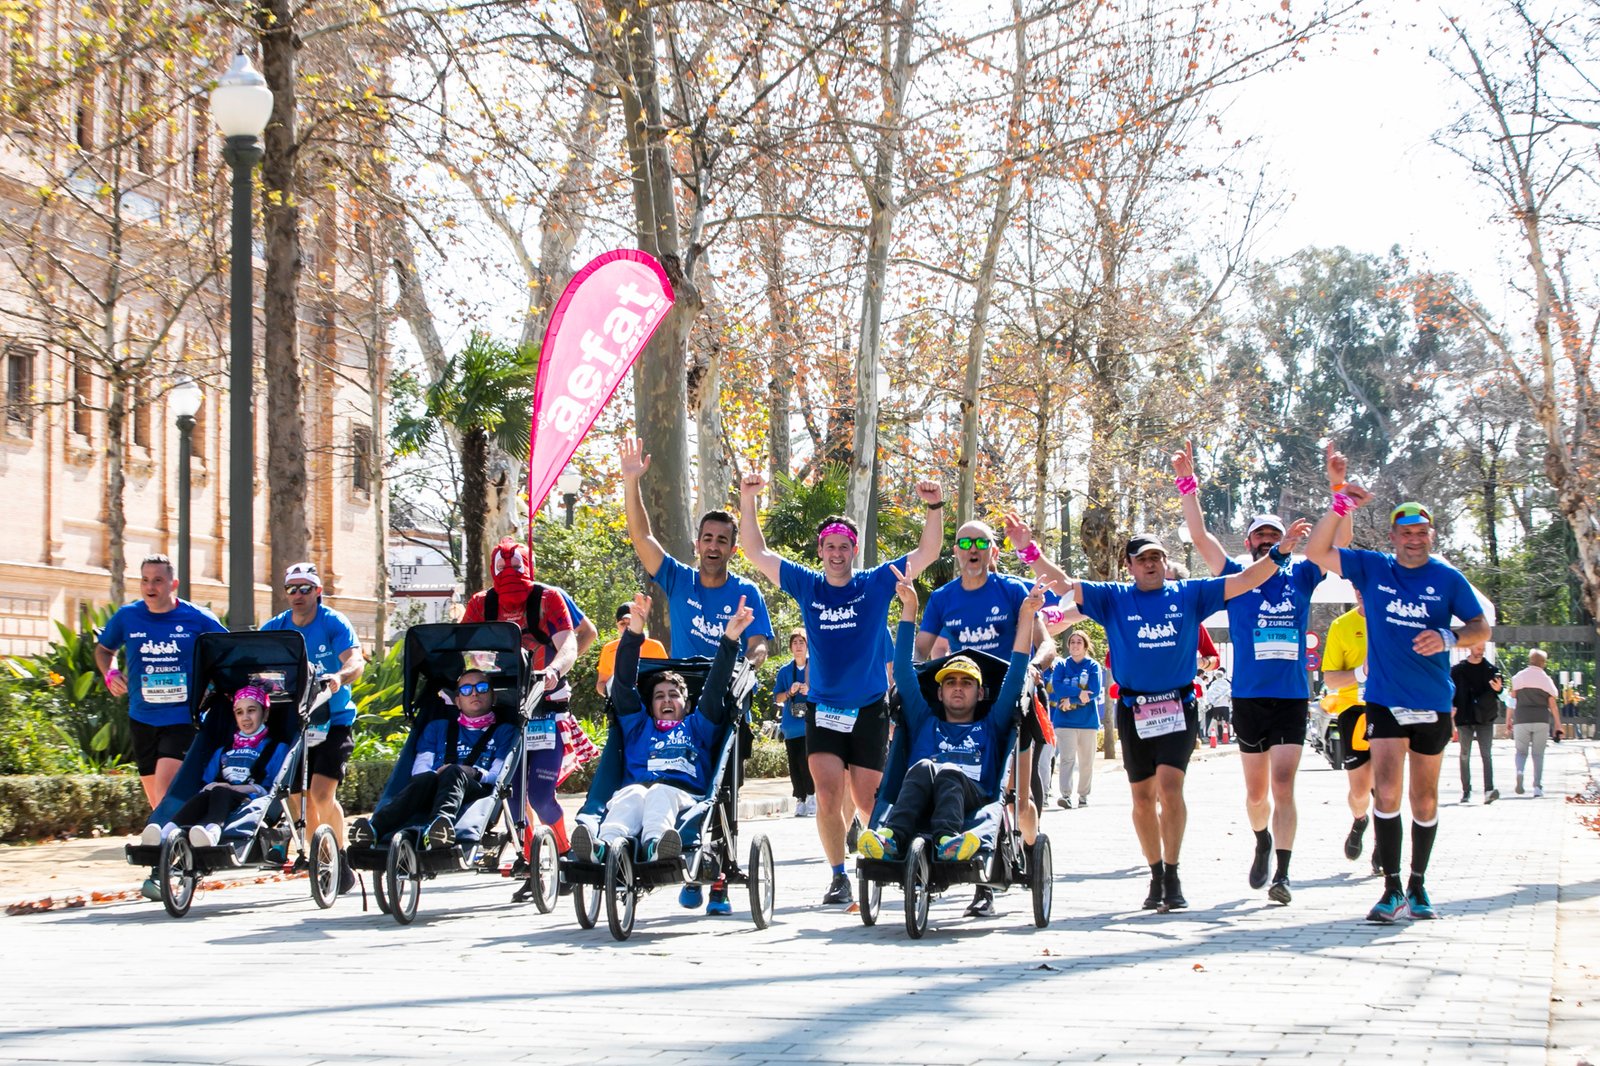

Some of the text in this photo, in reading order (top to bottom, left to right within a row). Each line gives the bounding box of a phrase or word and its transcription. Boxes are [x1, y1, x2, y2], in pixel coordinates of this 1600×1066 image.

[548, 282, 658, 433] aefat
[566, 296, 665, 441] www.aefat.es
[690, 629, 721, 647] #imparable
[1148, 692, 1175, 703] ZURICH
[824, 713, 841, 721] AEFAT
[1150, 706, 1167, 716] 7516
